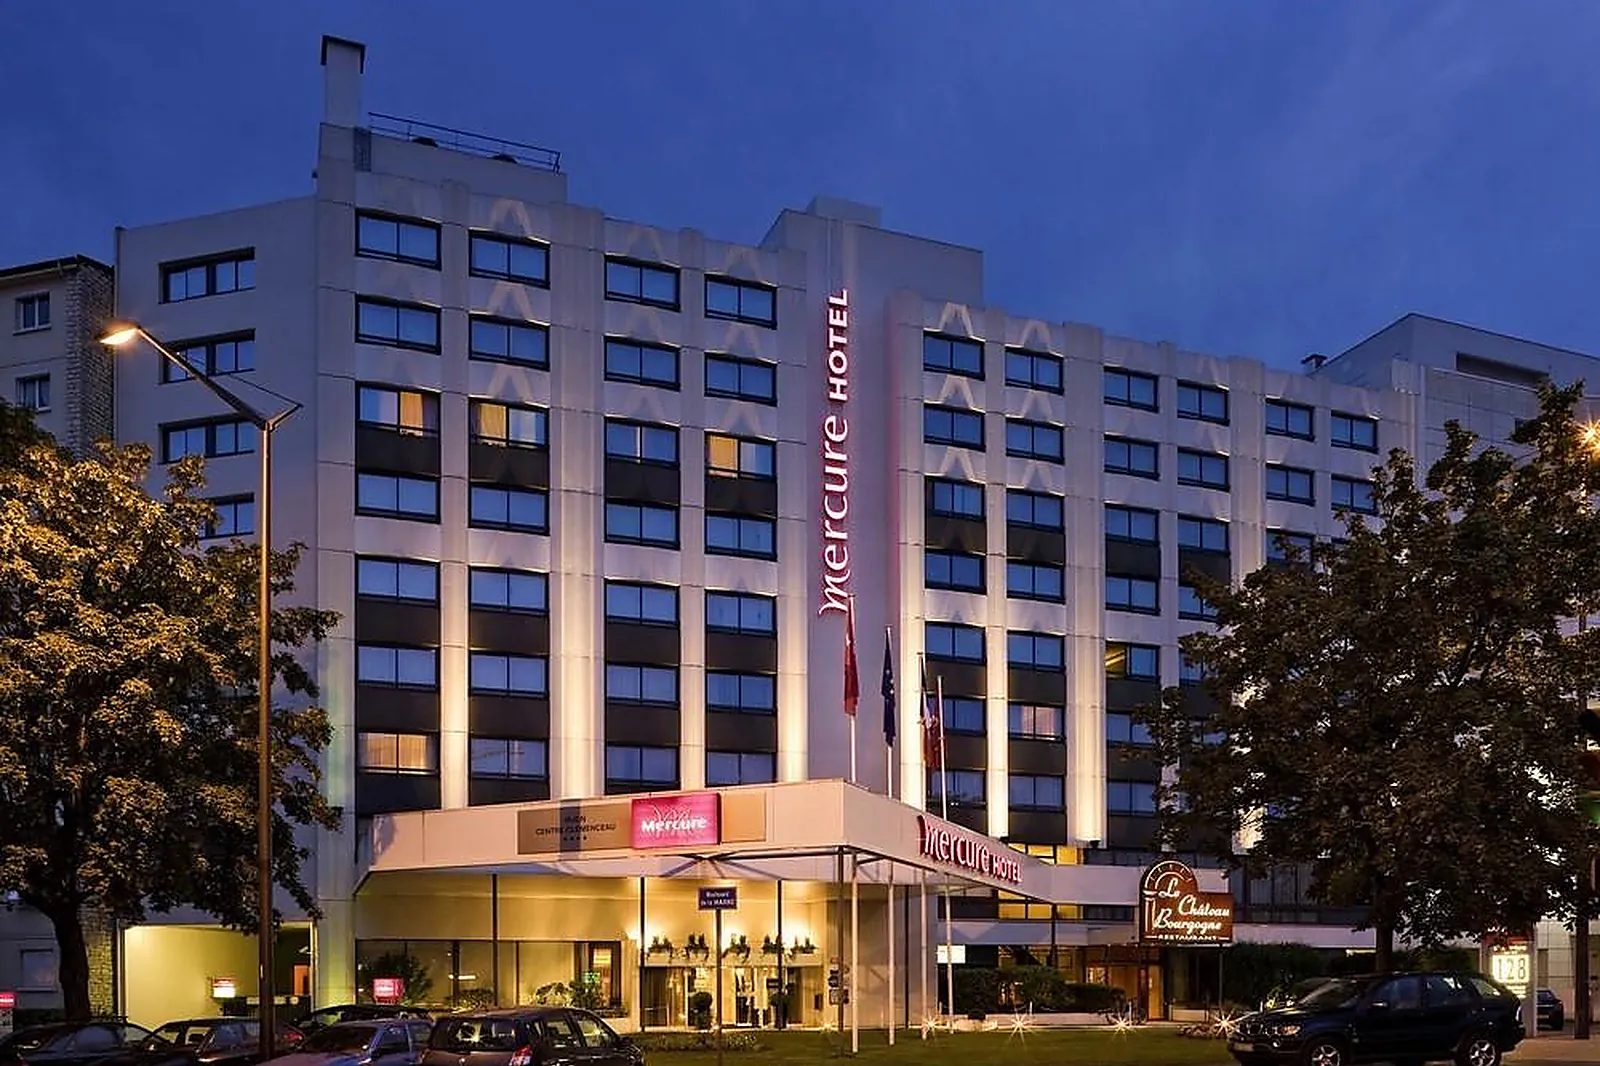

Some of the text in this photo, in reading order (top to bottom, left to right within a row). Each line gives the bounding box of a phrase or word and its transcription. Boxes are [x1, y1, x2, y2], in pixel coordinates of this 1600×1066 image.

[828, 289, 848, 402] HOTEL
[992, 853, 1023, 882] HOTEL
[1158, 877, 1181, 897] Le
[1153, 908, 1222, 935] Bourgogne
[1497, 958, 1527, 980] 128
